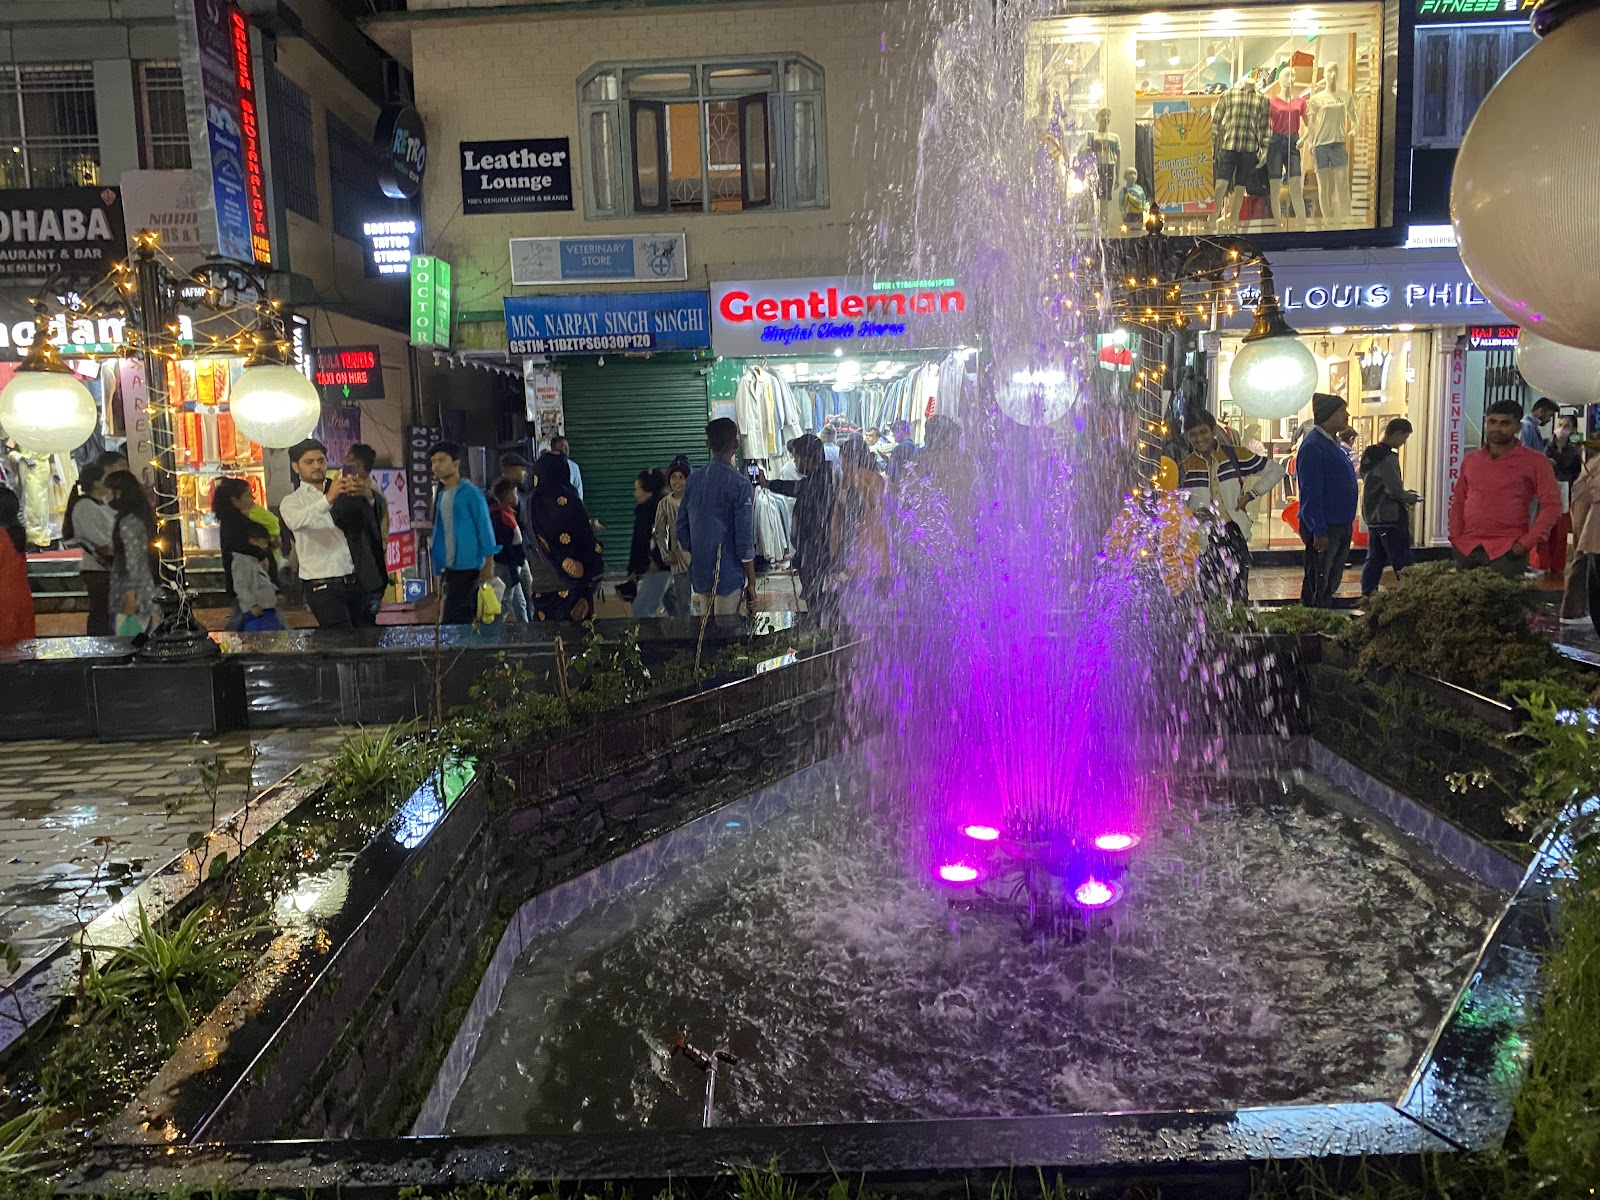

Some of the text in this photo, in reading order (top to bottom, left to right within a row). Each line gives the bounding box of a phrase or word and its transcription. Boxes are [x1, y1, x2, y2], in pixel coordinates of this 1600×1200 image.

[392, 128, 425, 172] RETRO
[464, 148, 566, 171] Leather
[480, 174, 552, 191] Lounge
[483, 196, 509, 204] GENUINE
[510, 195, 536, 203] LEATHER
[253, 234, 270, 252] PURE
[566, 243, 626, 255] VETERINARY
[60, 249, 70, 259] &
[74, 248, 102, 259] BAR
[582, 256, 612, 266] STORE
[416, 257, 430, 342] DOCTOR
[719, 287, 966, 322] Gentleman
[1284, 283, 1493, 309] LOUIS PHIL
[511, 308, 704, 338] M/S. NARPAT SINGH SINGHI
[1471, 328, 1492, 338] RAJ
[340, 352, 375, 368] TRAVELS
[1453, 349, 1463, 385] RAJ
[316, 371, 368, 384] TAXI ON HIRE
[412, 427, 427, 507] NORBULA
